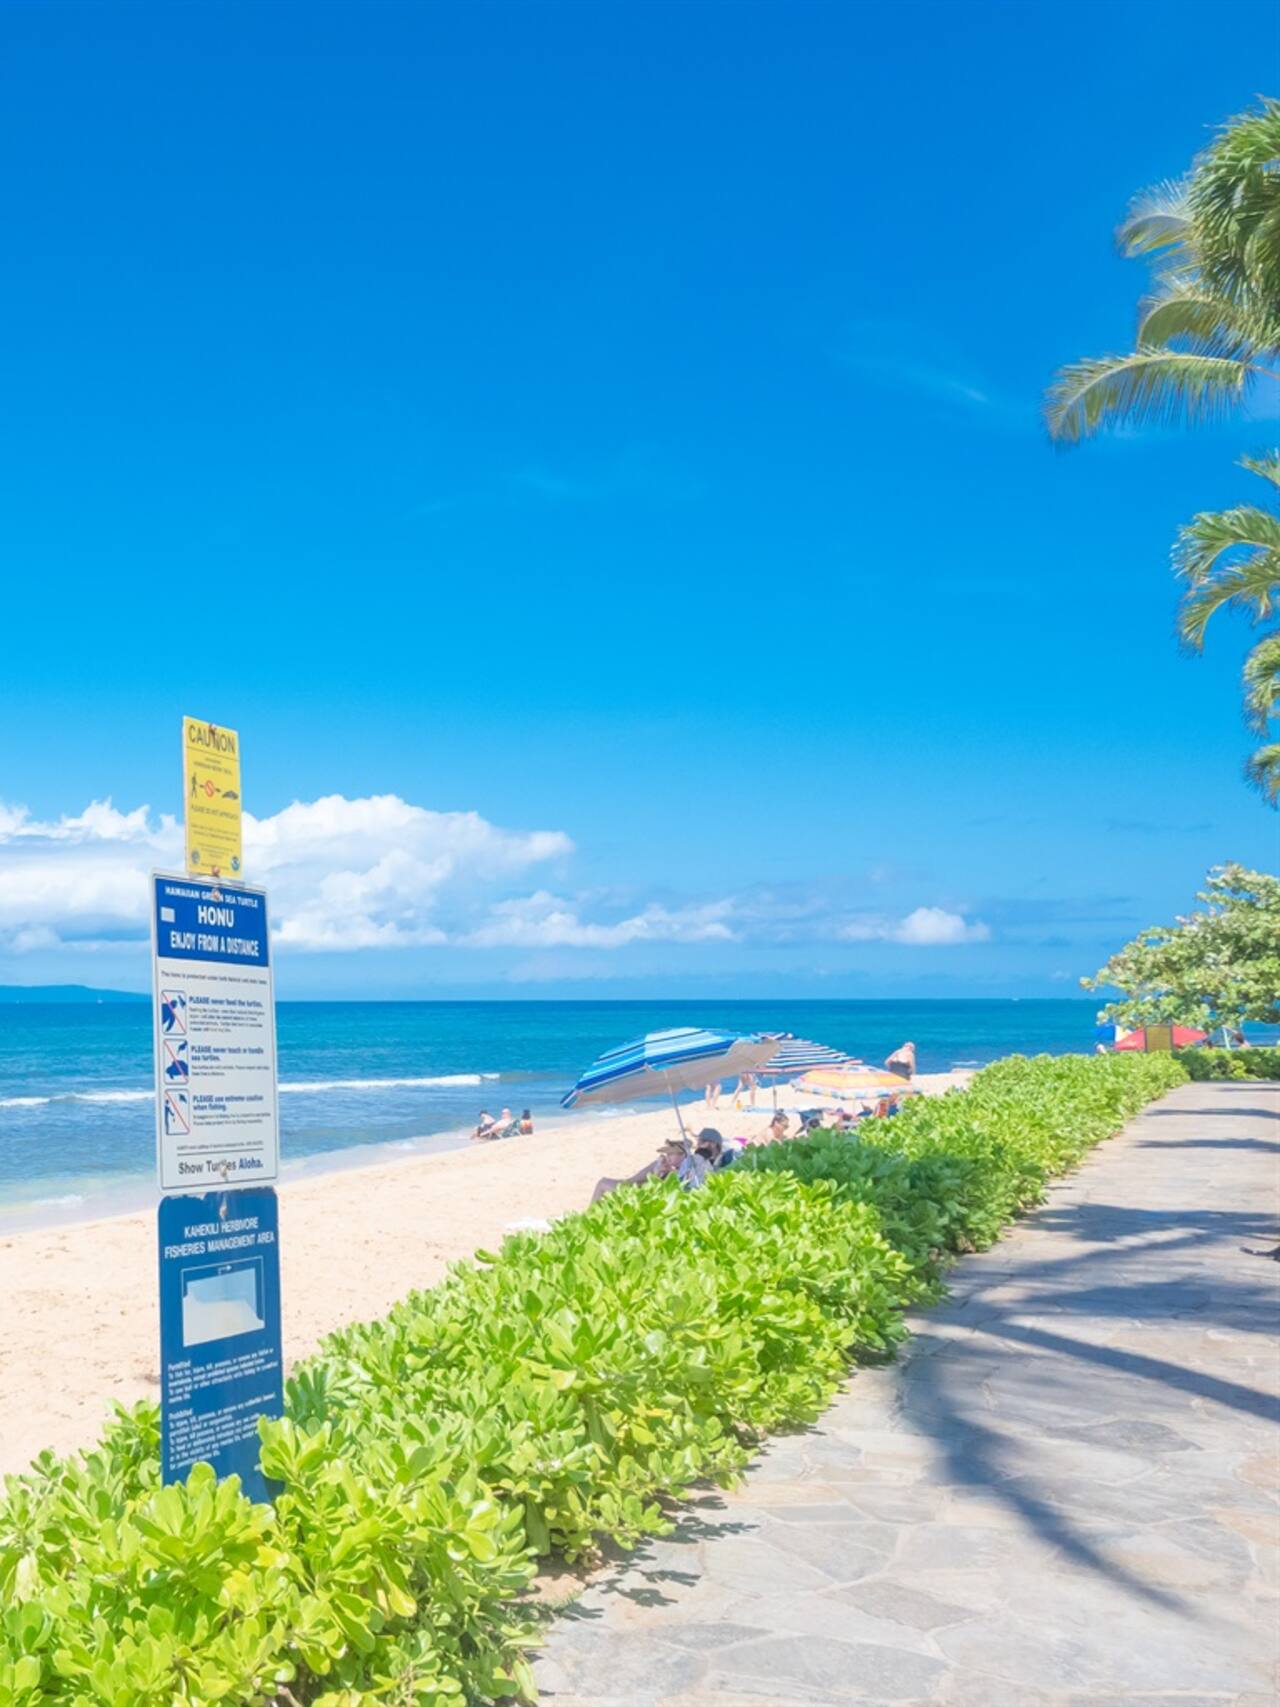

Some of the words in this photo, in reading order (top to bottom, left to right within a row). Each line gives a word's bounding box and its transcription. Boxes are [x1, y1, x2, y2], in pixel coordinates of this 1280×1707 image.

[165, 886, 200, 900] HAWAIIAN
[201, 891, 224, 903] GRN
[225, 894, 236, 905] SEA
[237, 896, 258, 908] TURTLE
[198, 905, 234, 928] HONU
[171, 930, 196, 951] ENJOY
[198, 933, 219, 953] FROM
[220, 936, 226, 954] A
[227, 937, 259, 957] DISTANCE
[189, 996, 210, 1004] PLEASE
[178, 1161, 203, 1175] Show
[239, 1156, 263, 1170] Aloha.
[164, 1241, 206, 1260] FISHERIES
[207, 1233, 256, 1253] MANAGEMENT
[257, 1230, 275, 1245] AREA
